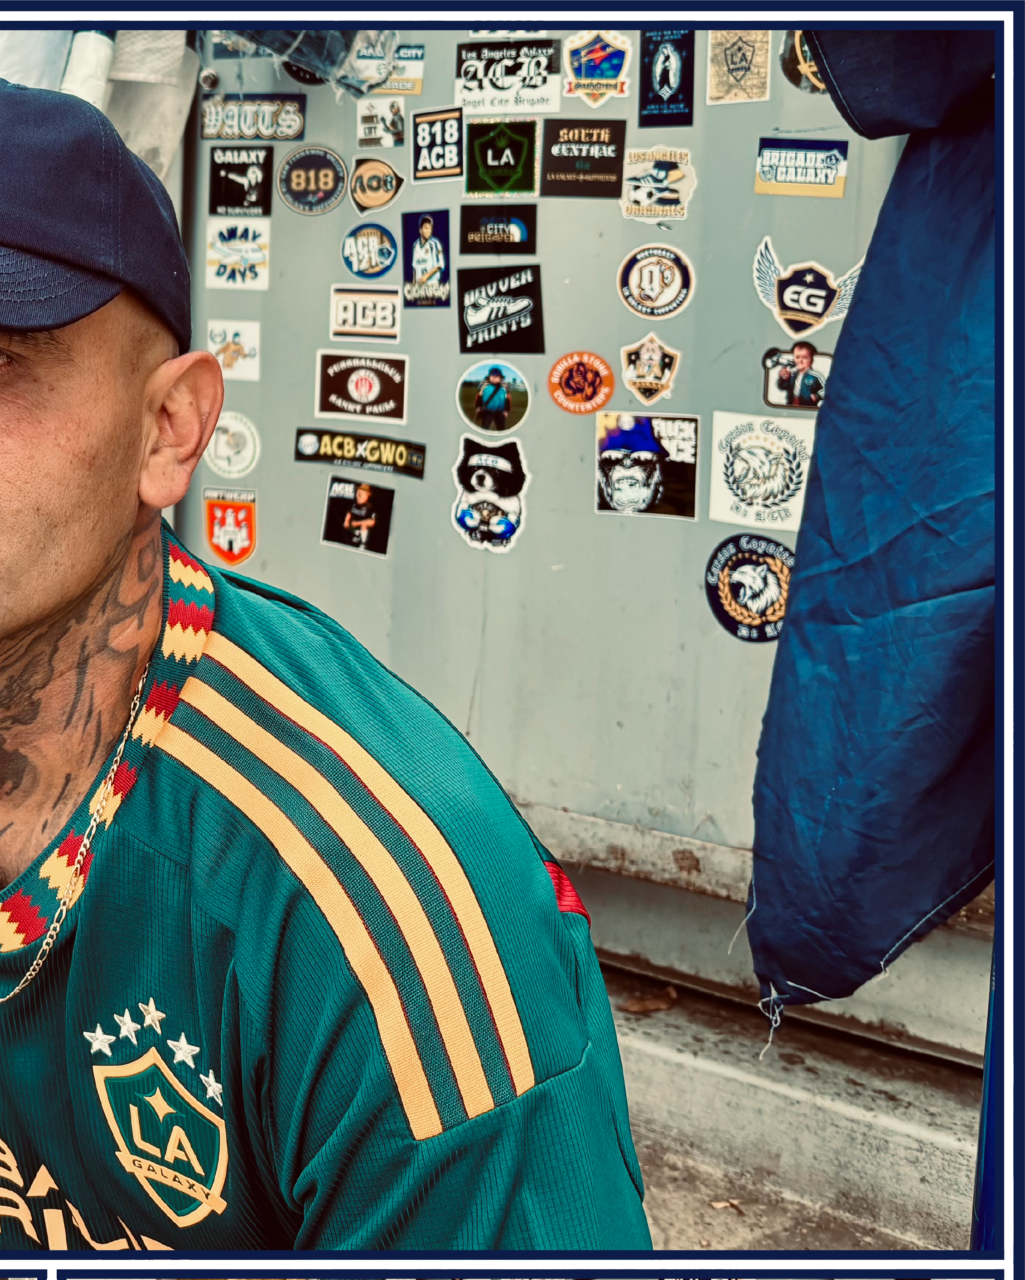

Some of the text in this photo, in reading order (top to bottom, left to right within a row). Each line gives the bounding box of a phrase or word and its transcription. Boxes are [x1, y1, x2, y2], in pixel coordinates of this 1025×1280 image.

[481, 48, 516, 61] Angeles
[730, 52, 748, 65] LA
[460, 56, 548, 94] ACB
[201, 100, 304, 139] WATTS
[417, 119, 459, 148] 818
[558, 127, 611, 143] SOUTH
[214, 149, 267, 164] GALAXY
[418, 145, 458, 171] ACB
[487, 148, 515, 167] LA
[551, 143, 618, 159] CENTRAL
[762, 150, 826, 167] BRIGADE
[291, 169, 334, 191] 818
[776, 167, 837, 184] GALAXY
[218, 226, 262, 242] AWAY
[343, 236, 380, 258] ACB
[215, 264, 259, 283] DAYS
[783, 284, 827, 314] EG
[336, 300, 397, 329] ACB
[551, 353, 609, 384] GORILLA STONE
[130, 1103, 204, 1176] LA
[131, 1158, 213, 1201] GALAXY
